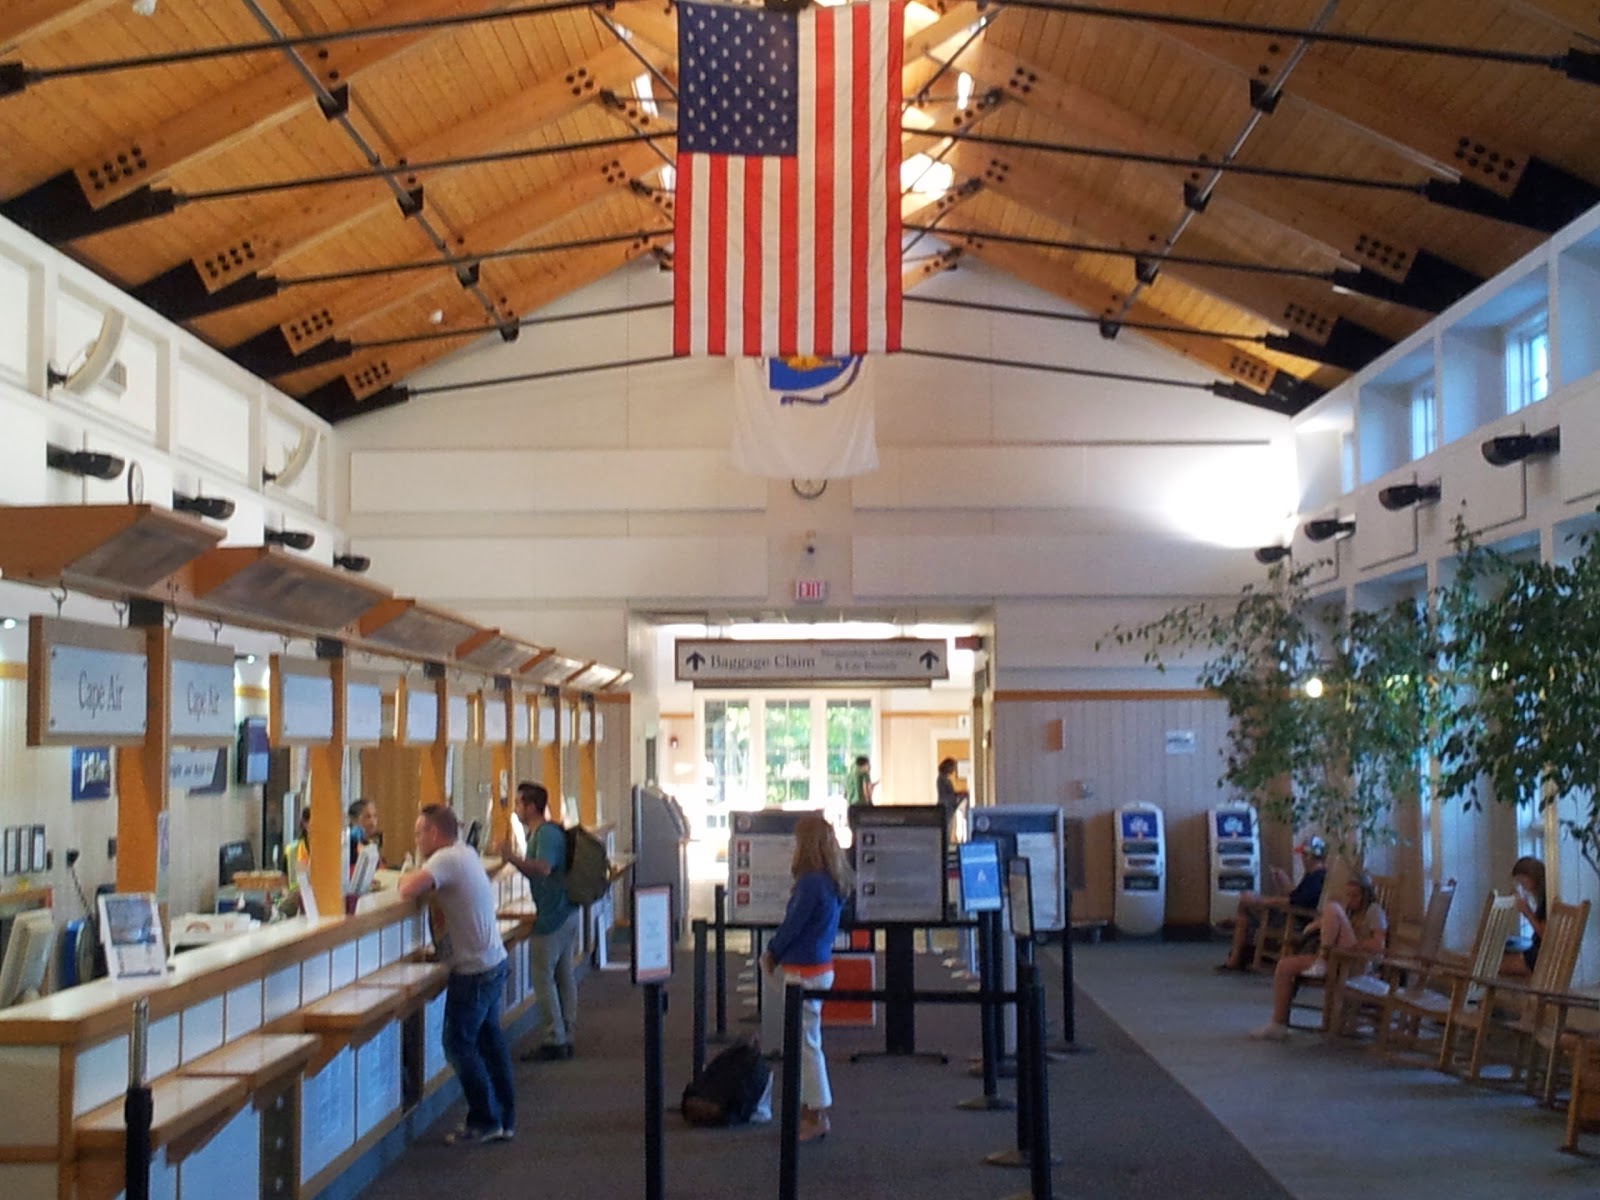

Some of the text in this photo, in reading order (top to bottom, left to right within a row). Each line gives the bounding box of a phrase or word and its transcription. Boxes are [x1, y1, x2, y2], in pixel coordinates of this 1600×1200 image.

[711, 652, 770, 671] Baggage
[774, 653, 816, 669] Claim
[78, 670, 125, 719] Cape Air
[187, 681, 220, 722] Cape Air
